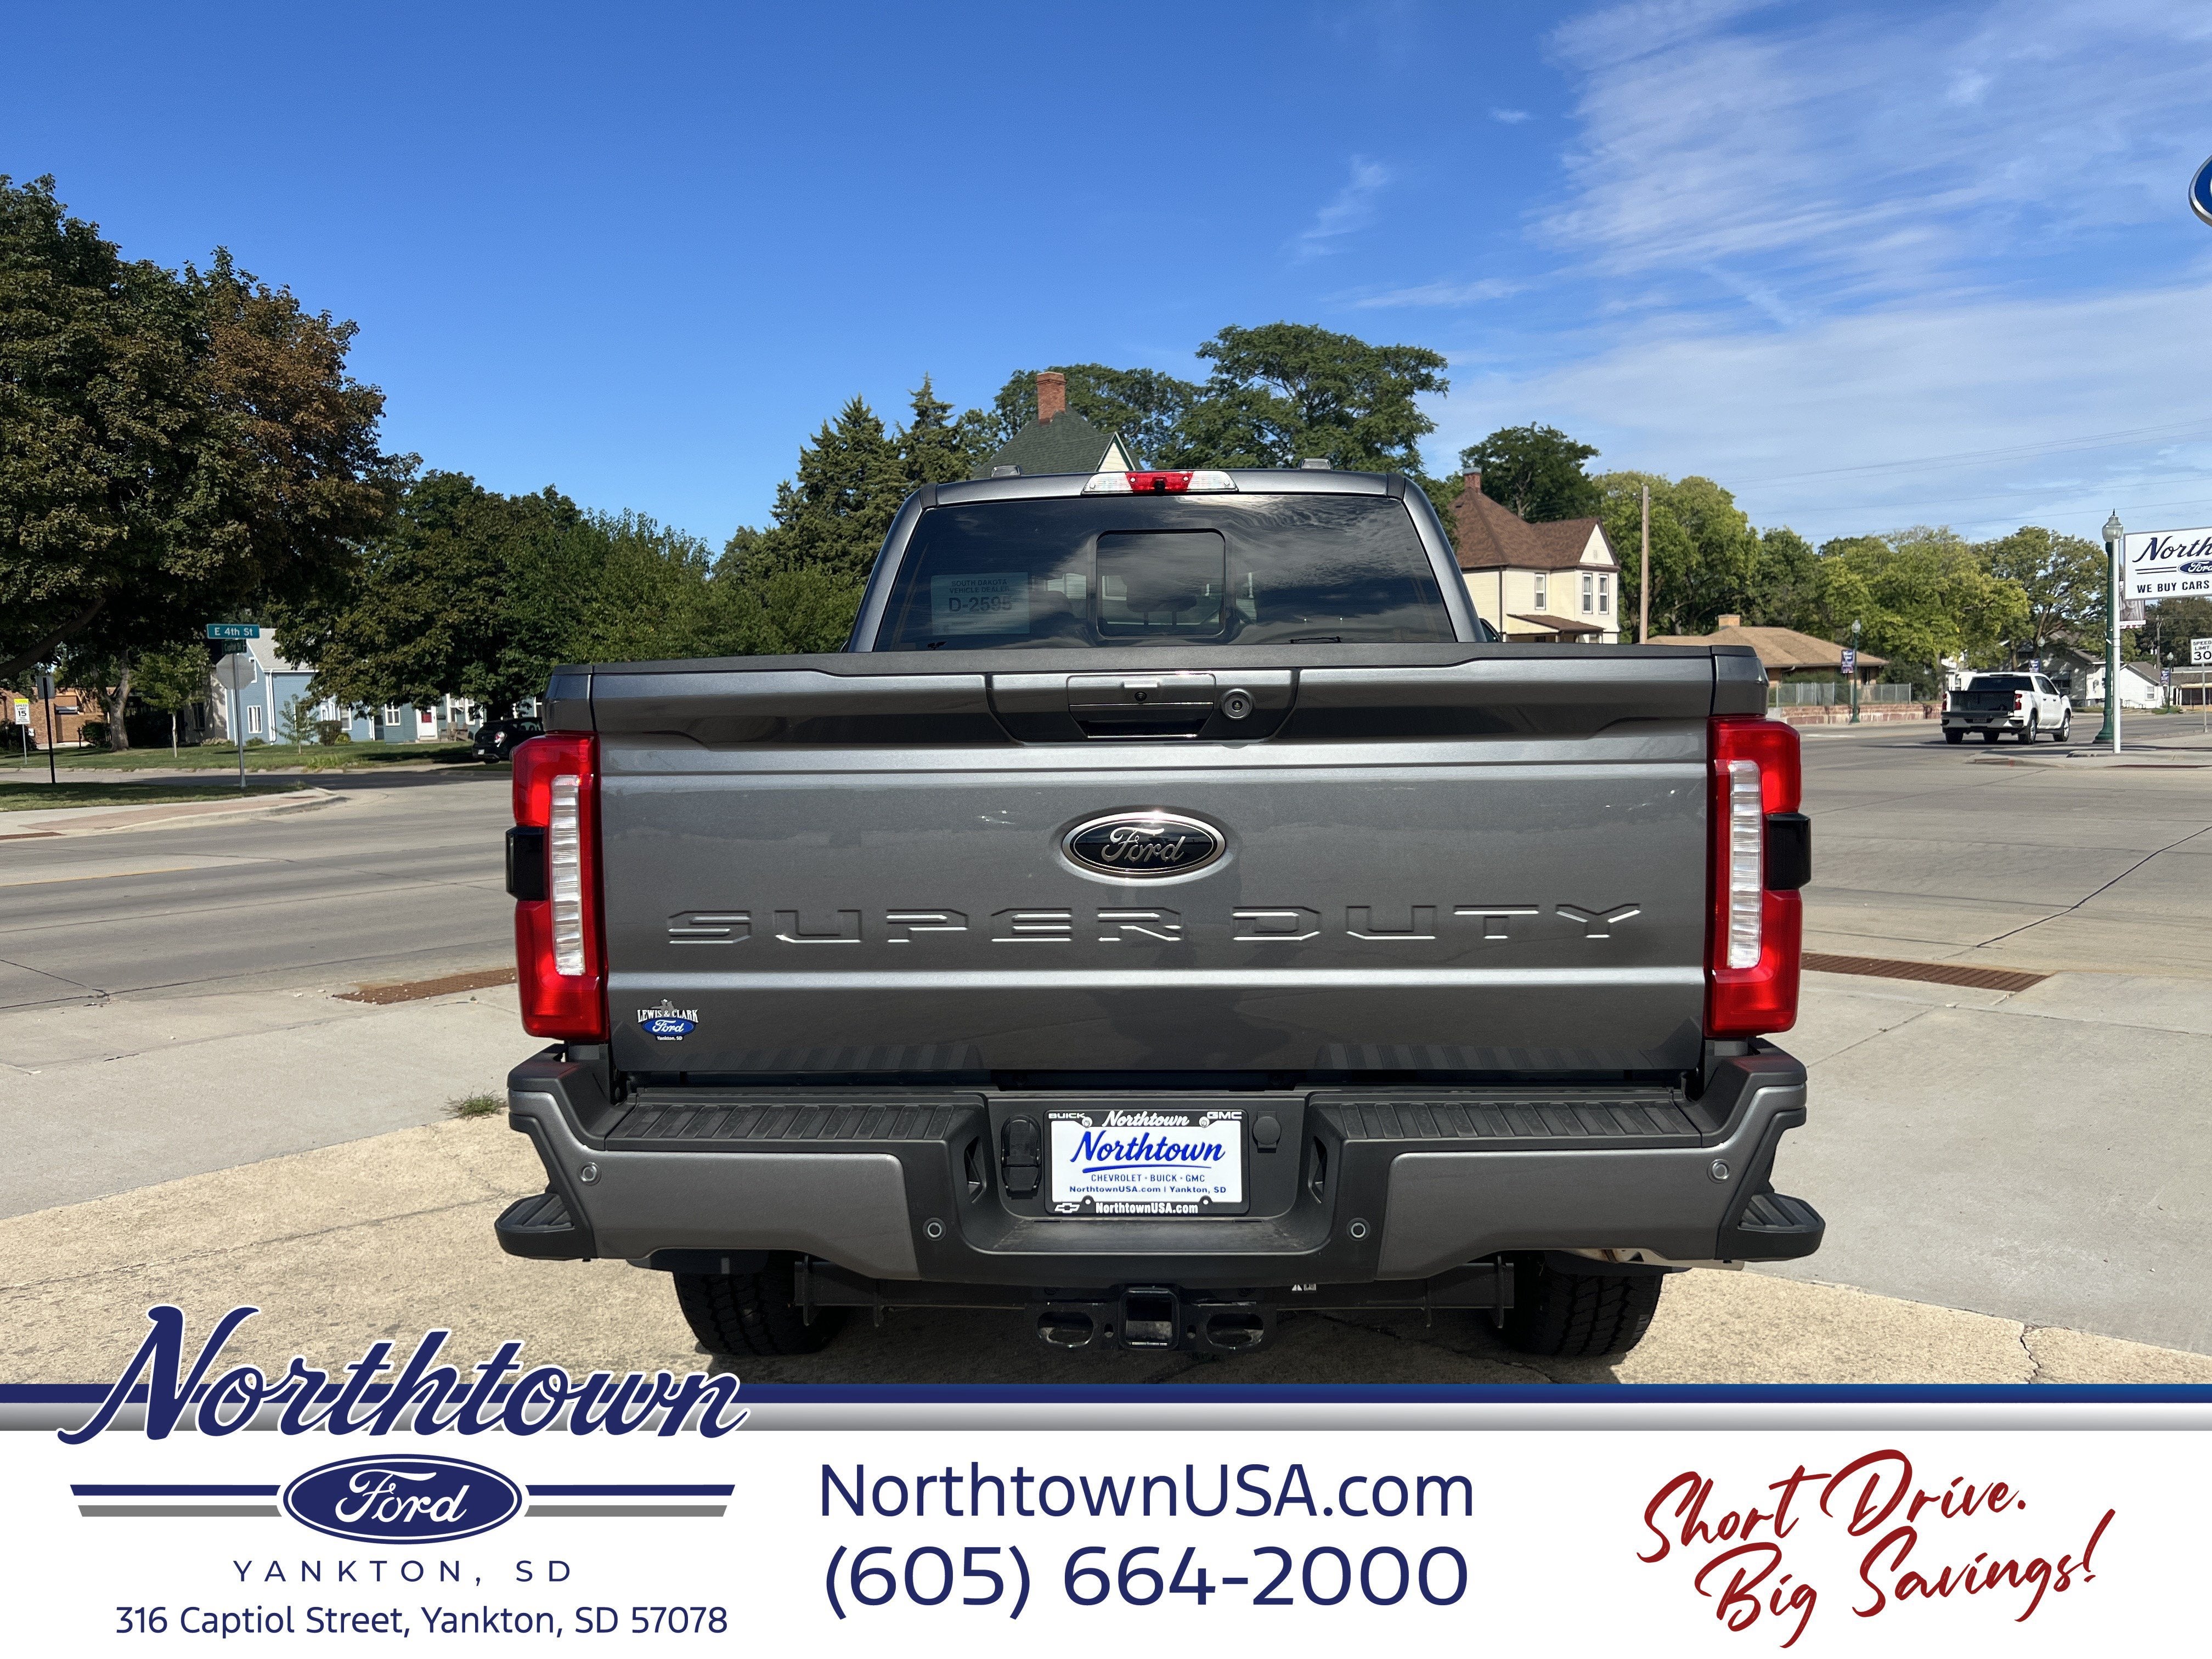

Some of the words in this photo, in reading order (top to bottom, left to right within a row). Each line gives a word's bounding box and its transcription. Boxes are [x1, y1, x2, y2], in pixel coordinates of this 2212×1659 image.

[2137, 584, 2152, 593] WE
[2157, 582, 2177, 592] BUY
[2182, 580, 2210, 590] CARS
[949, 596, 1013, 612] D-2595
[215, 627, 221, 636] E
[224, 627, 240, 636] 4th
[244, 627, 253, 636] St
[2194, 651, 2212, 661] 30
[1101, 827, 1186, 862] Ford
[668, 906, 1182, 944] SUPER
[1233, 904, 1641, 940] DUTY
[637, 1009, 662, 1023] LEWIS
[672, 1009, 699, 1023] CLARK
[652, 1019, 684, 1032] Ford
[1102, 1110, 1190, 1127] Northtown
[1206, 1111, 1242, 1120] GMC
[1070, 1130, 1226, 1162] Northtown
[1096, 1202, 1198, 1214] NorthtownUSA.com
